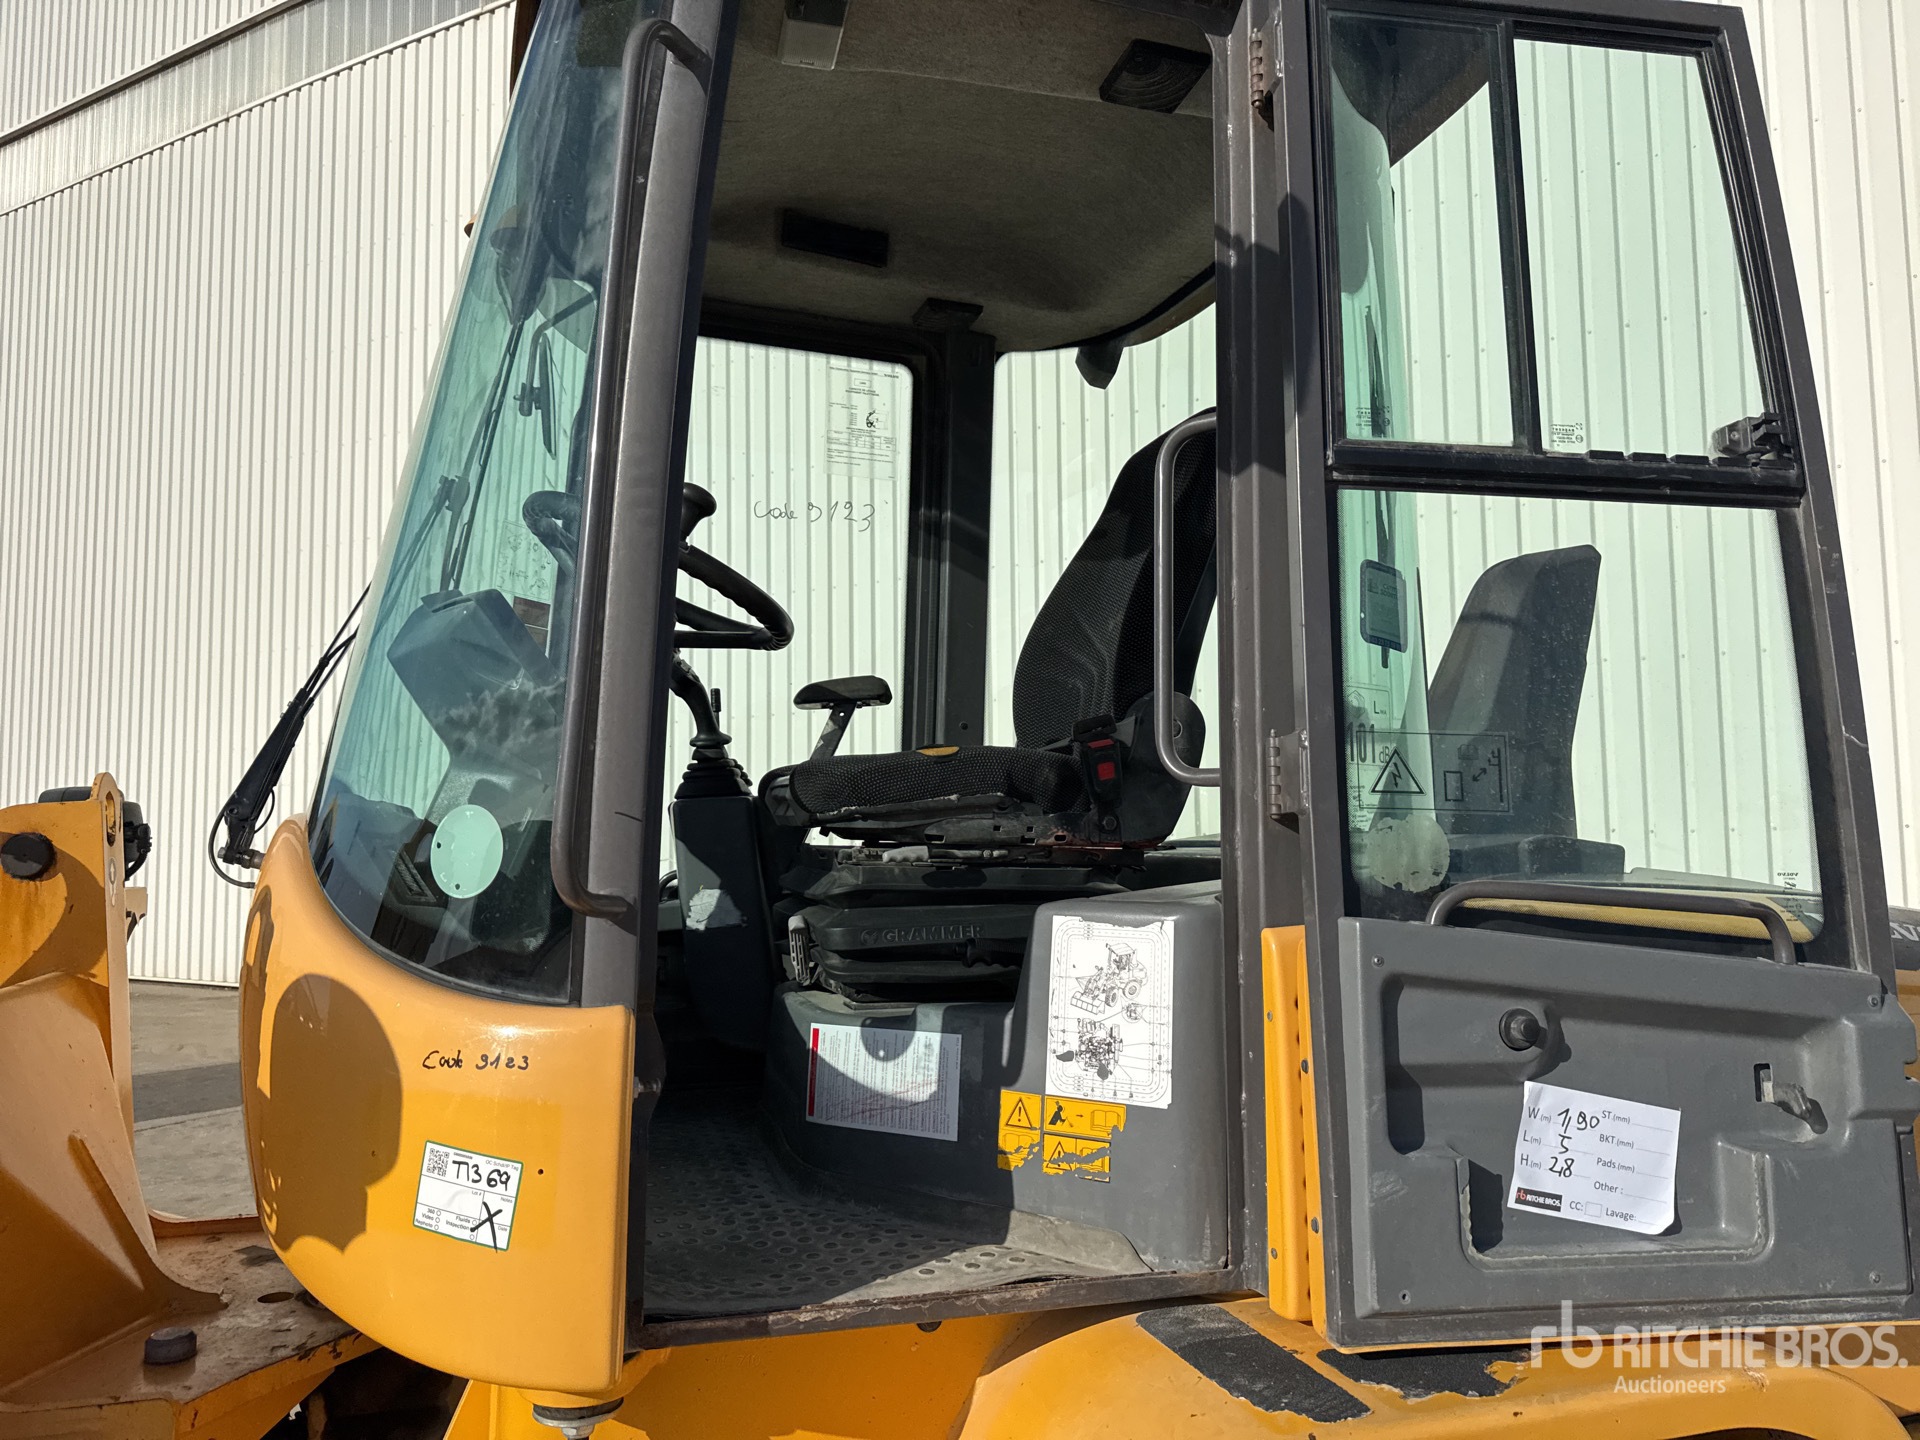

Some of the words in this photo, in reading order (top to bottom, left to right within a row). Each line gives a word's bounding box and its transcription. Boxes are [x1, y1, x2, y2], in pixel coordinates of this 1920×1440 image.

[882, 924, 984, 942] GRAMMER
[1558, 1133, 1573, 1155] 5
[1593, 1181, 1619, 1194] Other
